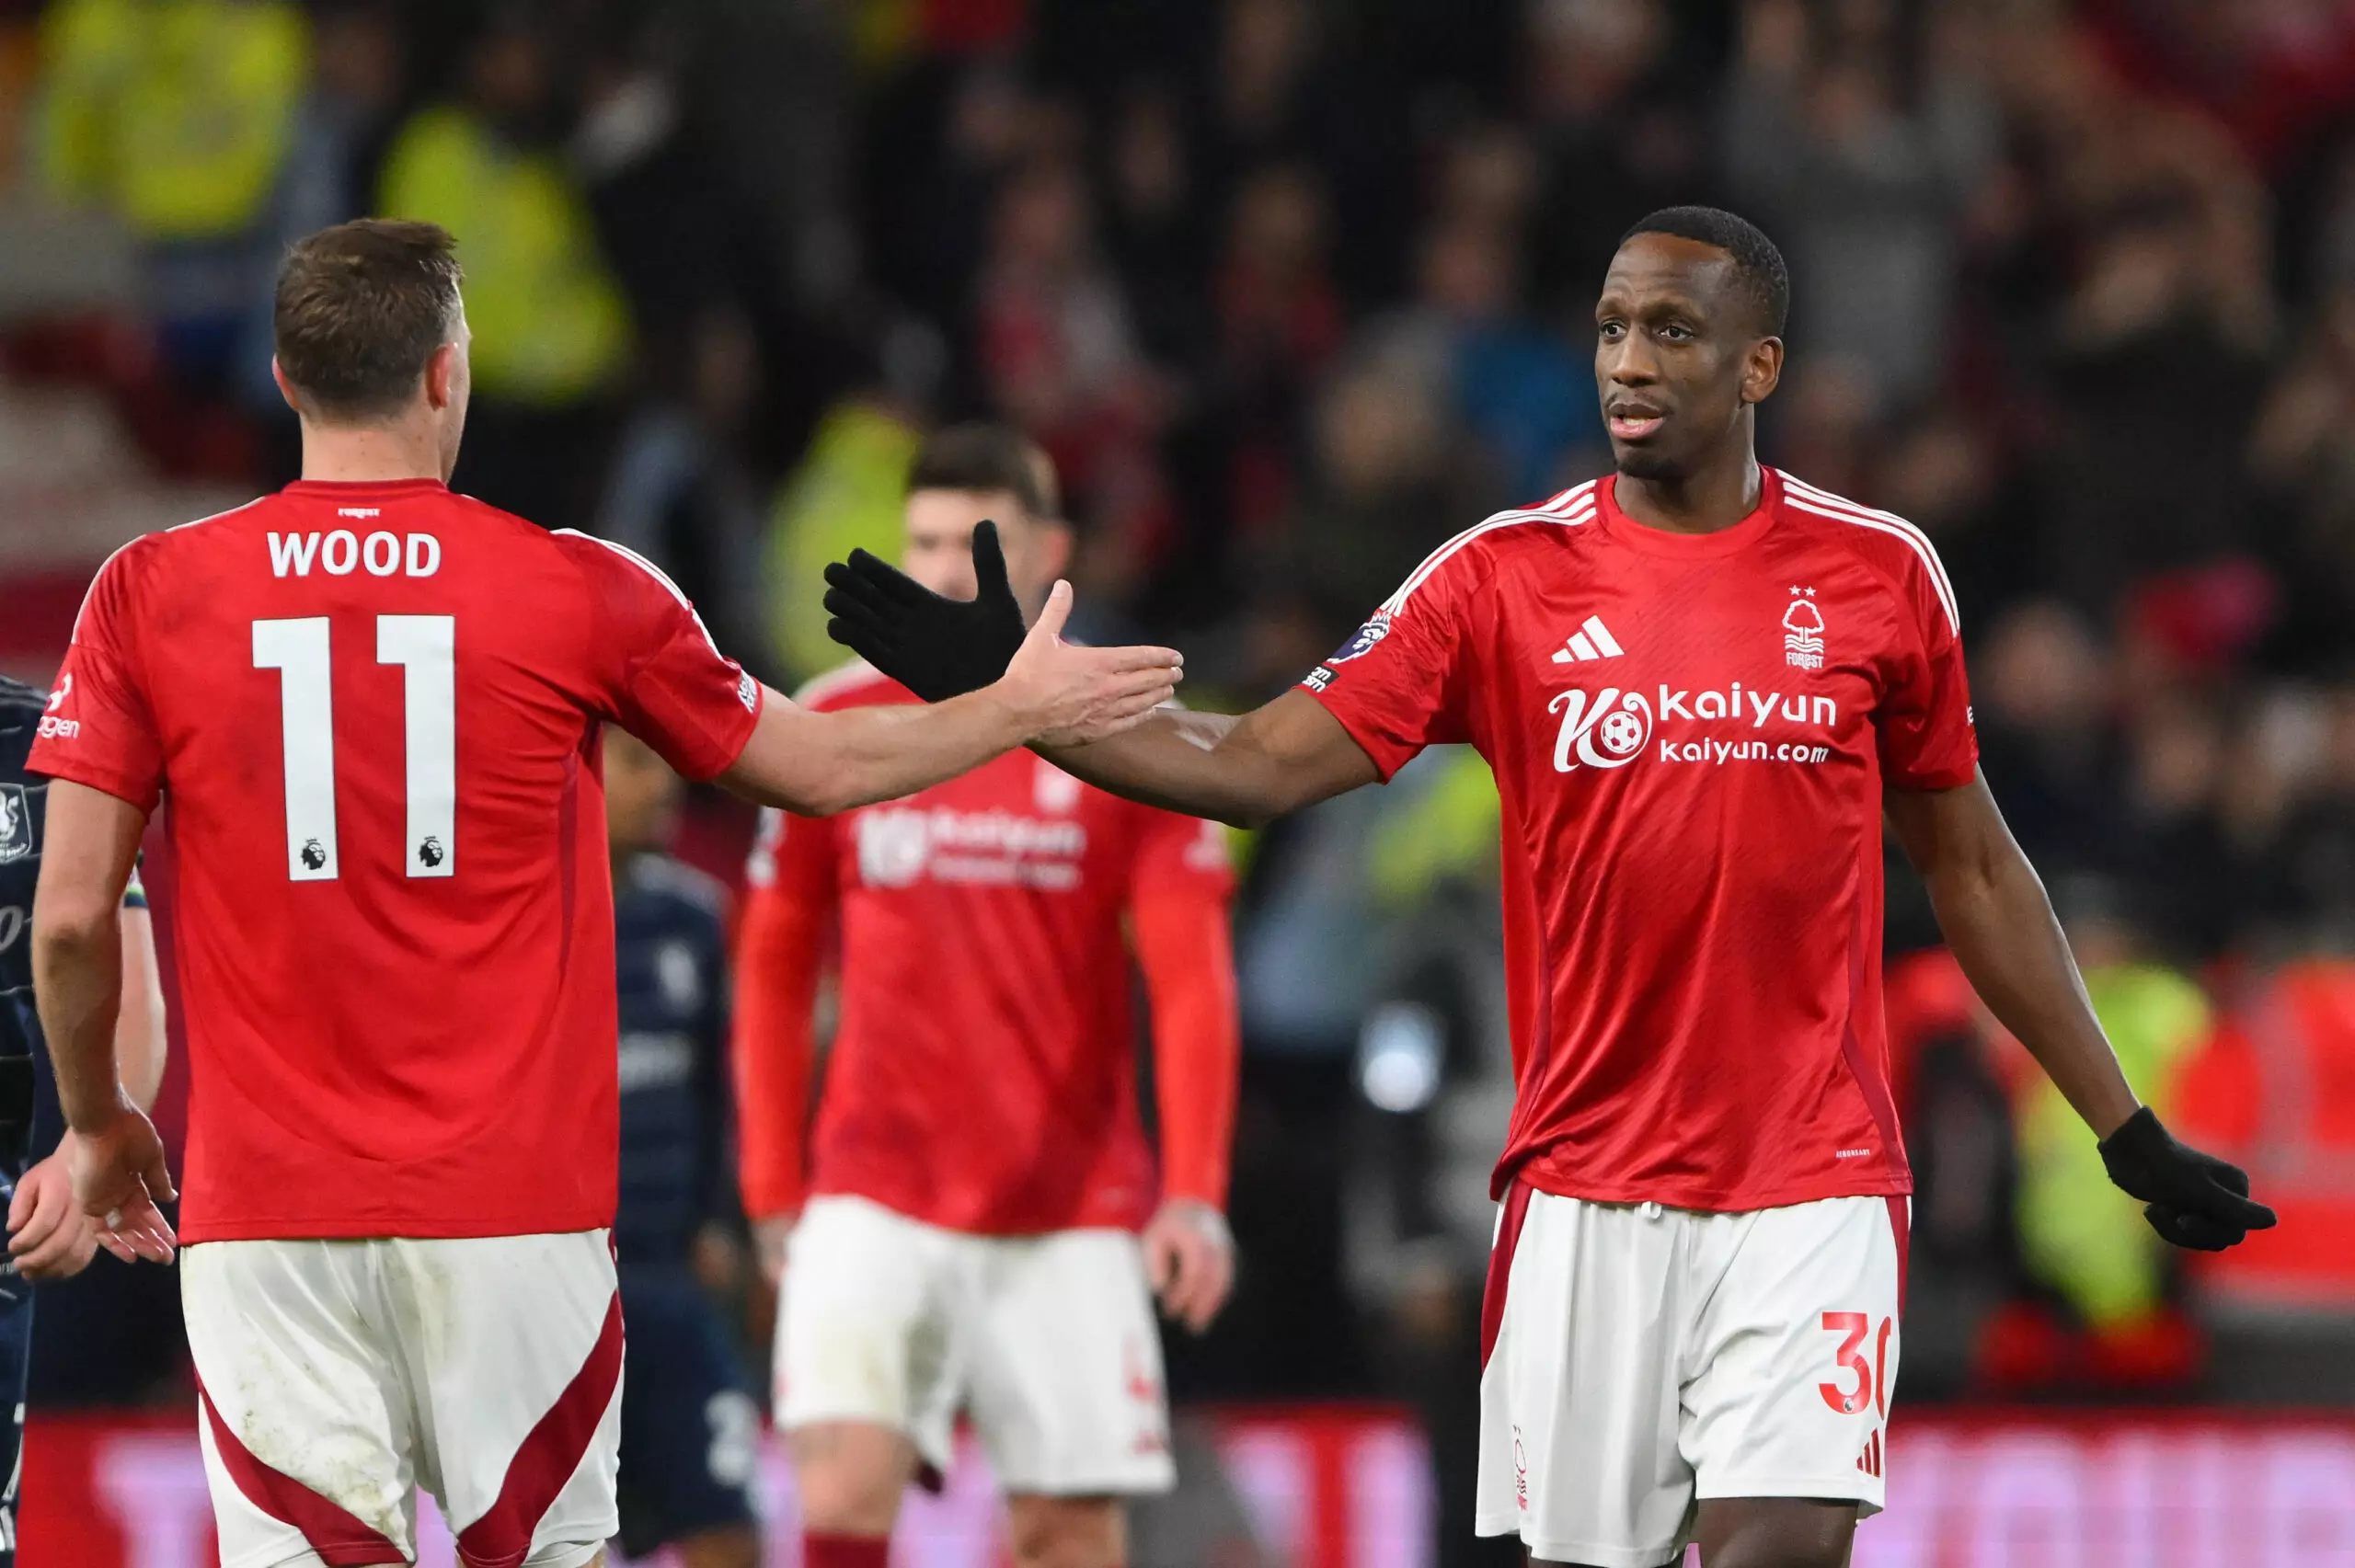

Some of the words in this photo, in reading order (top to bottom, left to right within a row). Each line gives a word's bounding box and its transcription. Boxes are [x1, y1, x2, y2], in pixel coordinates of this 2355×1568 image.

[268, 530, 441, 578] WOOD
[252, 615, 454, 880] 11
[1661, 738, 1828, 764] kaiyun.com
